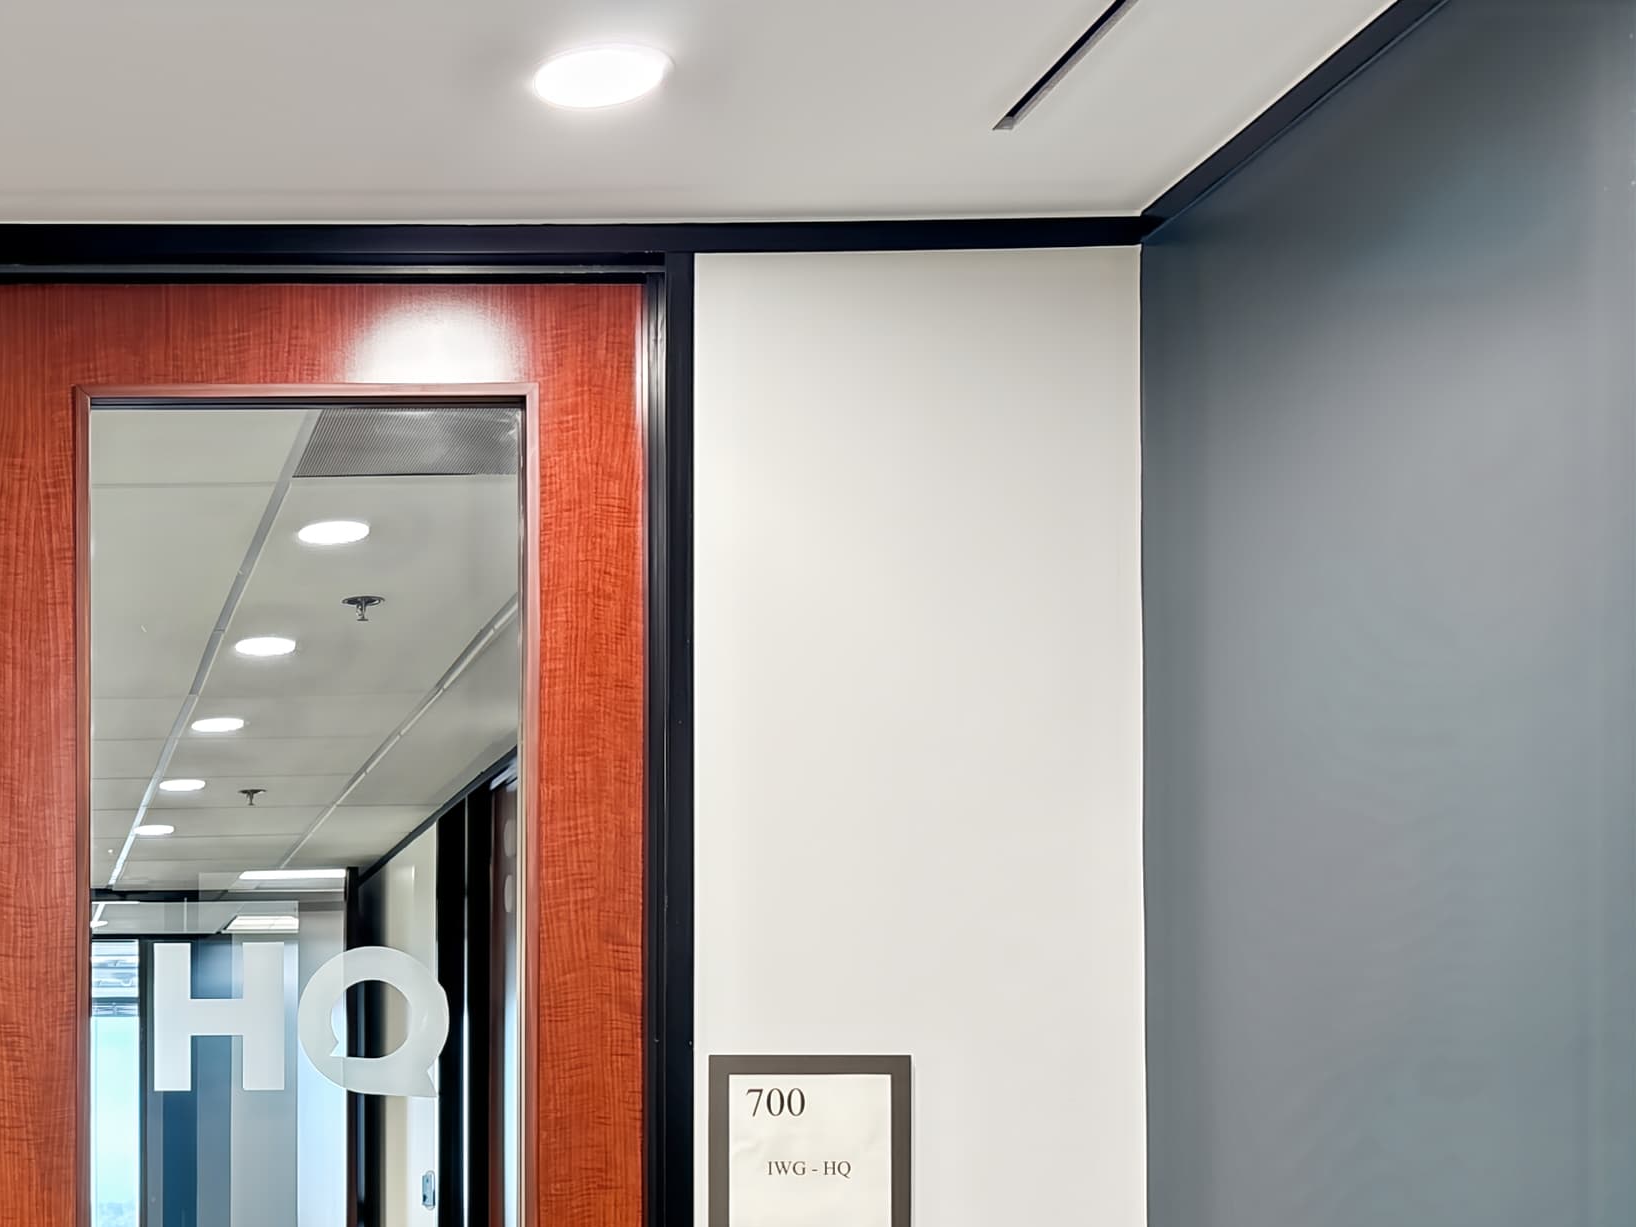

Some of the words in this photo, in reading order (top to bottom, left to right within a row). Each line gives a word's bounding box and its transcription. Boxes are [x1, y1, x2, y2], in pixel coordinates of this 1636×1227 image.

[154, 942, 450, 1097] HQ
[746, 1087, 806, 1117] 700
[767, 1160, 807, 1176] IWG
[823, 1160, 852, 1178] HQ
